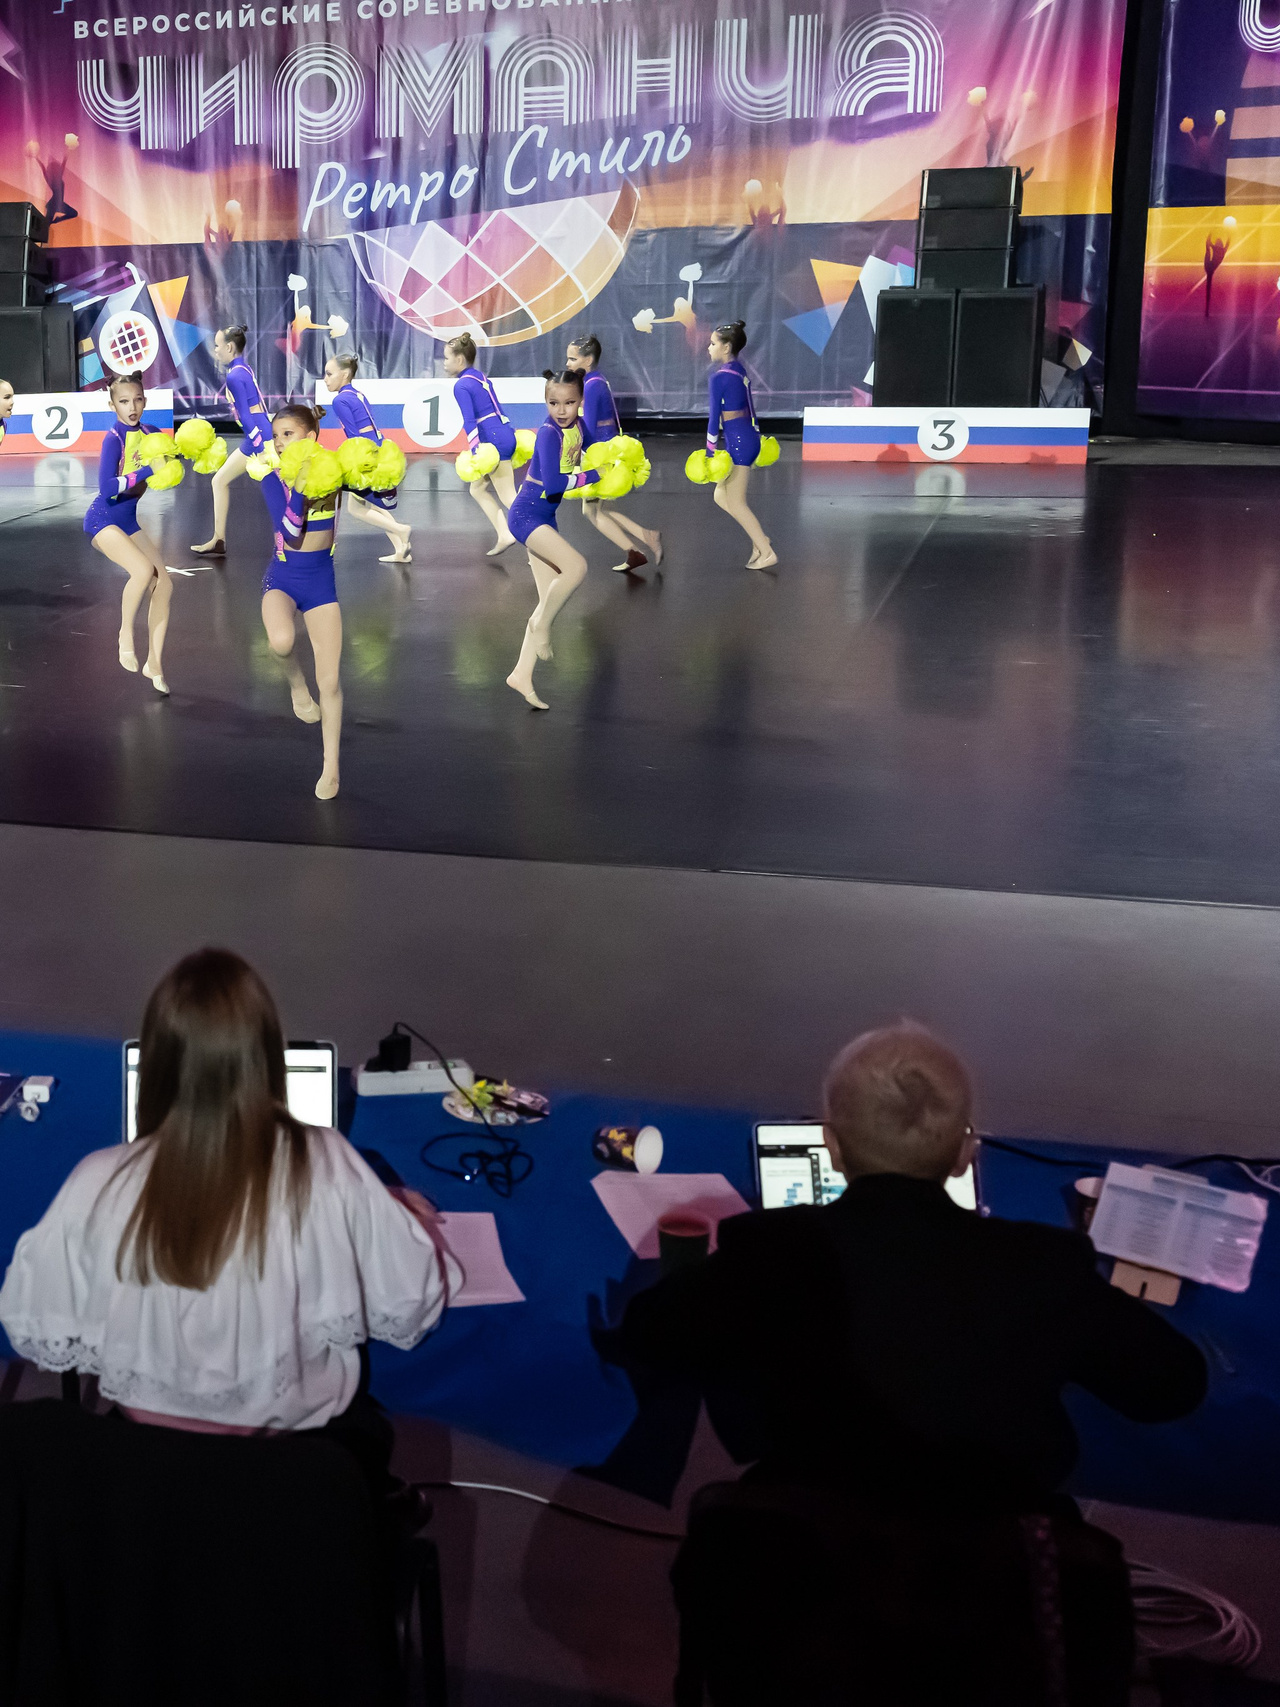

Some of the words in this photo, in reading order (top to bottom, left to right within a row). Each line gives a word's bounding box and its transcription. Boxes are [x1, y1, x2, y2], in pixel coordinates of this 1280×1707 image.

[74, 2, 341, 39] ВСЕРОССИЙСКИЕ
[356, 0, 633, 20] СОРЕВНО
[301, 161, 480, 232] Ретро
[503, 124, 692, 196] Стиль
[45, 405, 69, 440] 2
[422, 395, 445, 436] 1
[931, 419, 956, 451] 3
